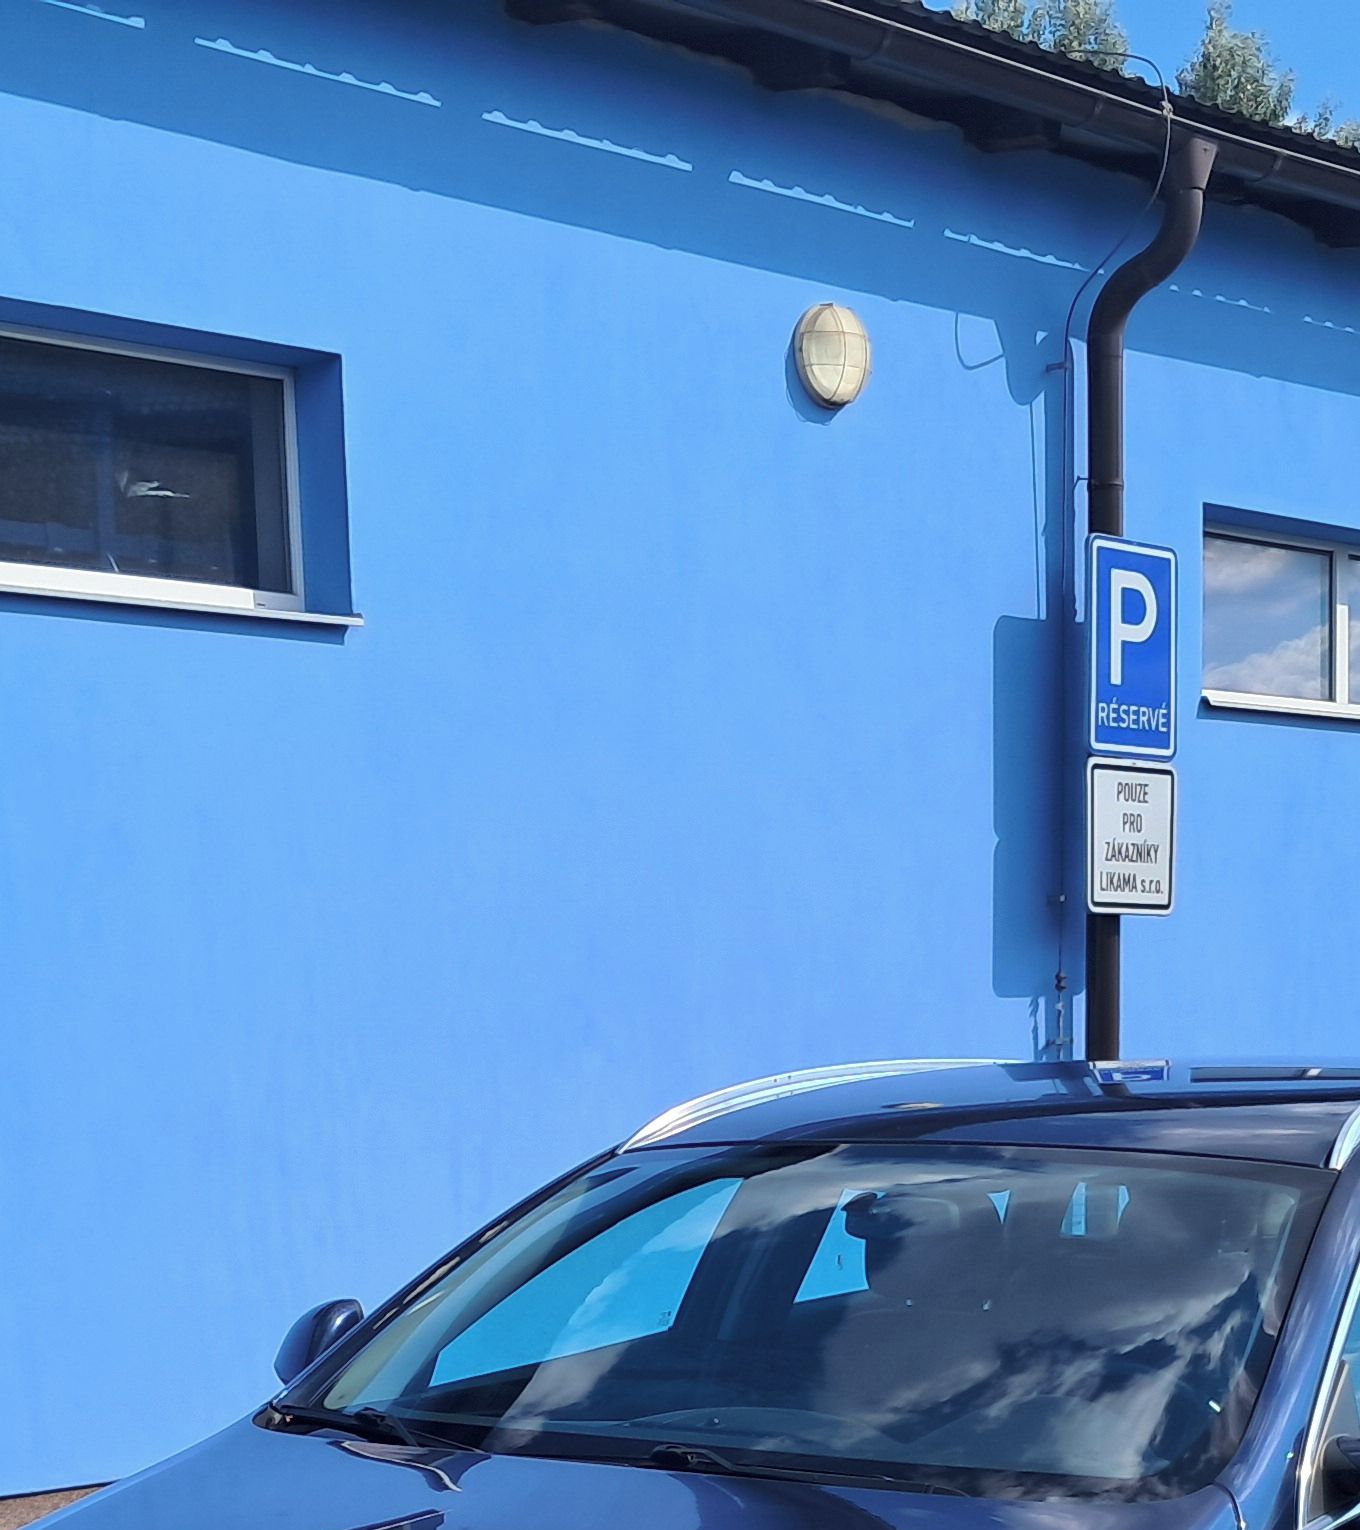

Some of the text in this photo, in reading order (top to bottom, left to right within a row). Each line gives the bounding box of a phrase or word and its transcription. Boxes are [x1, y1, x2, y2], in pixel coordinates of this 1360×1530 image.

[1110, 568, 1157, 685] P
[1098, 697, 1168, 732] RÉSERVÉ
[1116, 782, 1149, 803] POUZE
[1122, 812, 1142, 833] PRO
[1104, 838, 1159, 864] ZÁKAZNÍKY
[1100, 871, 1164, 894] LIKAMA s.r.o.
